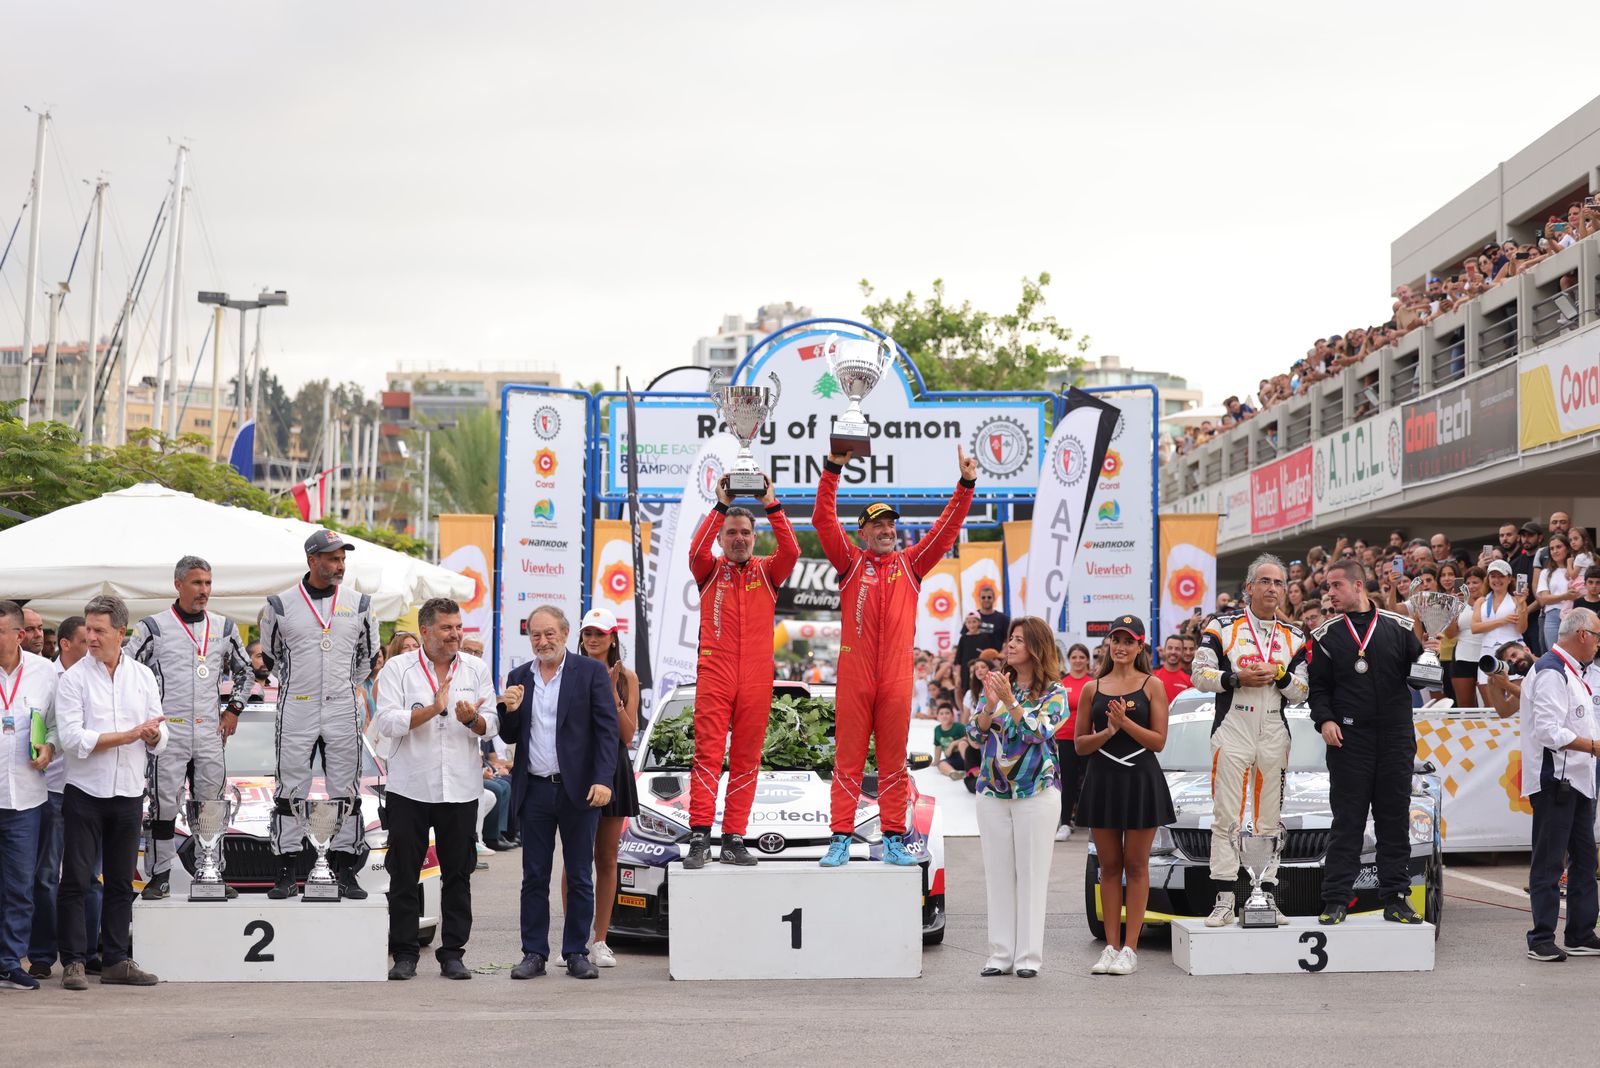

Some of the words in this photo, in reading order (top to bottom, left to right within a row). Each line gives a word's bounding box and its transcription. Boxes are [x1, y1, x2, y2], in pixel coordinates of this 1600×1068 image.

[1561, 352, 1600, 413] Cora
[788, 414, 817, 438] of
[1405, 389, 1471, 454] domtech
[620, 454, 660, 465] RLLY
[771, 455, 894, 484] FINSH
[535, 480, 555, 489] Coral
[1099, 481, 1120, 490] Coral
[521, 559, 565, 575] Viewtech
[1086, 561, 1132, 576] Viewtech
[527, 593, 566, 601] COMMERCIAL
[793, 592, 841, 609] driving
[662, 656, 694, 671] MEMBER
[620, 842, 665, 856] MEDCO
[781, 908, 802, 949] 1
[243, 919, 275, 962] 2
[1298, 931, 1329, 972] 3
